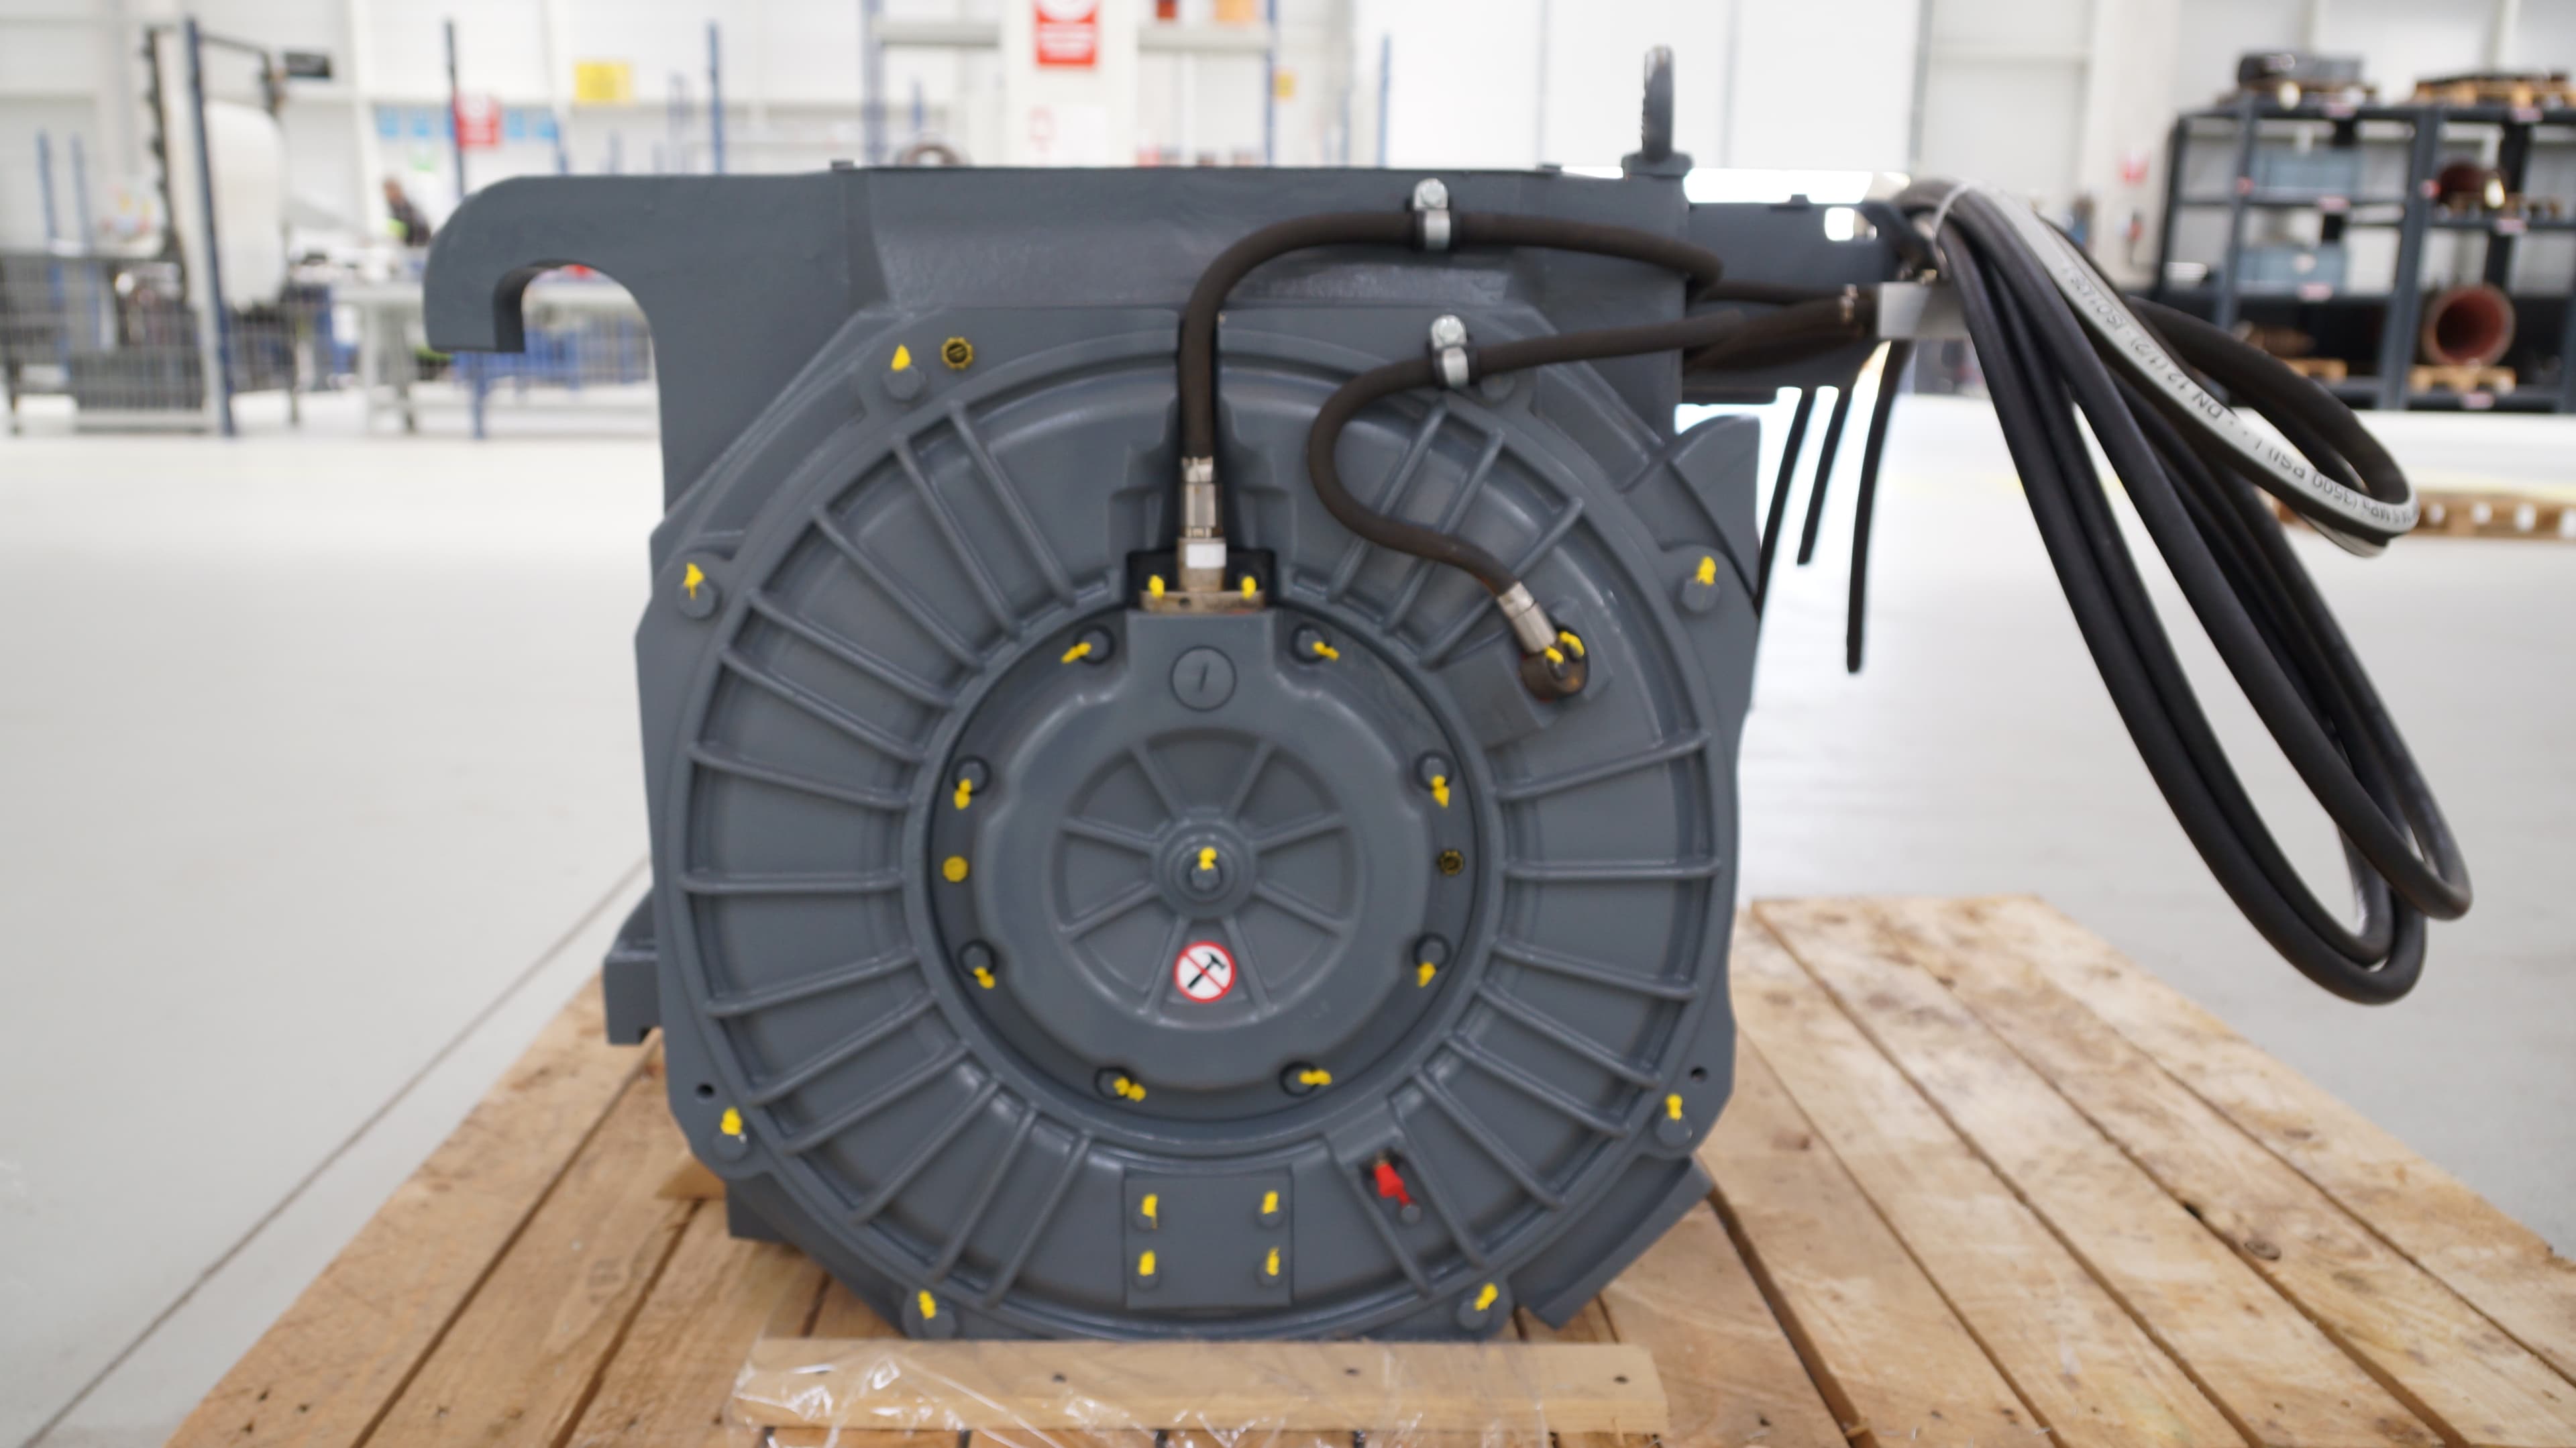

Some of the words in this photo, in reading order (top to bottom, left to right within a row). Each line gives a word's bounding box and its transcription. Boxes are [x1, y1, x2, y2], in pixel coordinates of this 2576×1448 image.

[2167, 372, 2191, 390] 12
[2192, 391, 2224, 419] DN
[2268, 447, 2306, 479] PSI)
[2312, 473, 2358, 509] (3500
